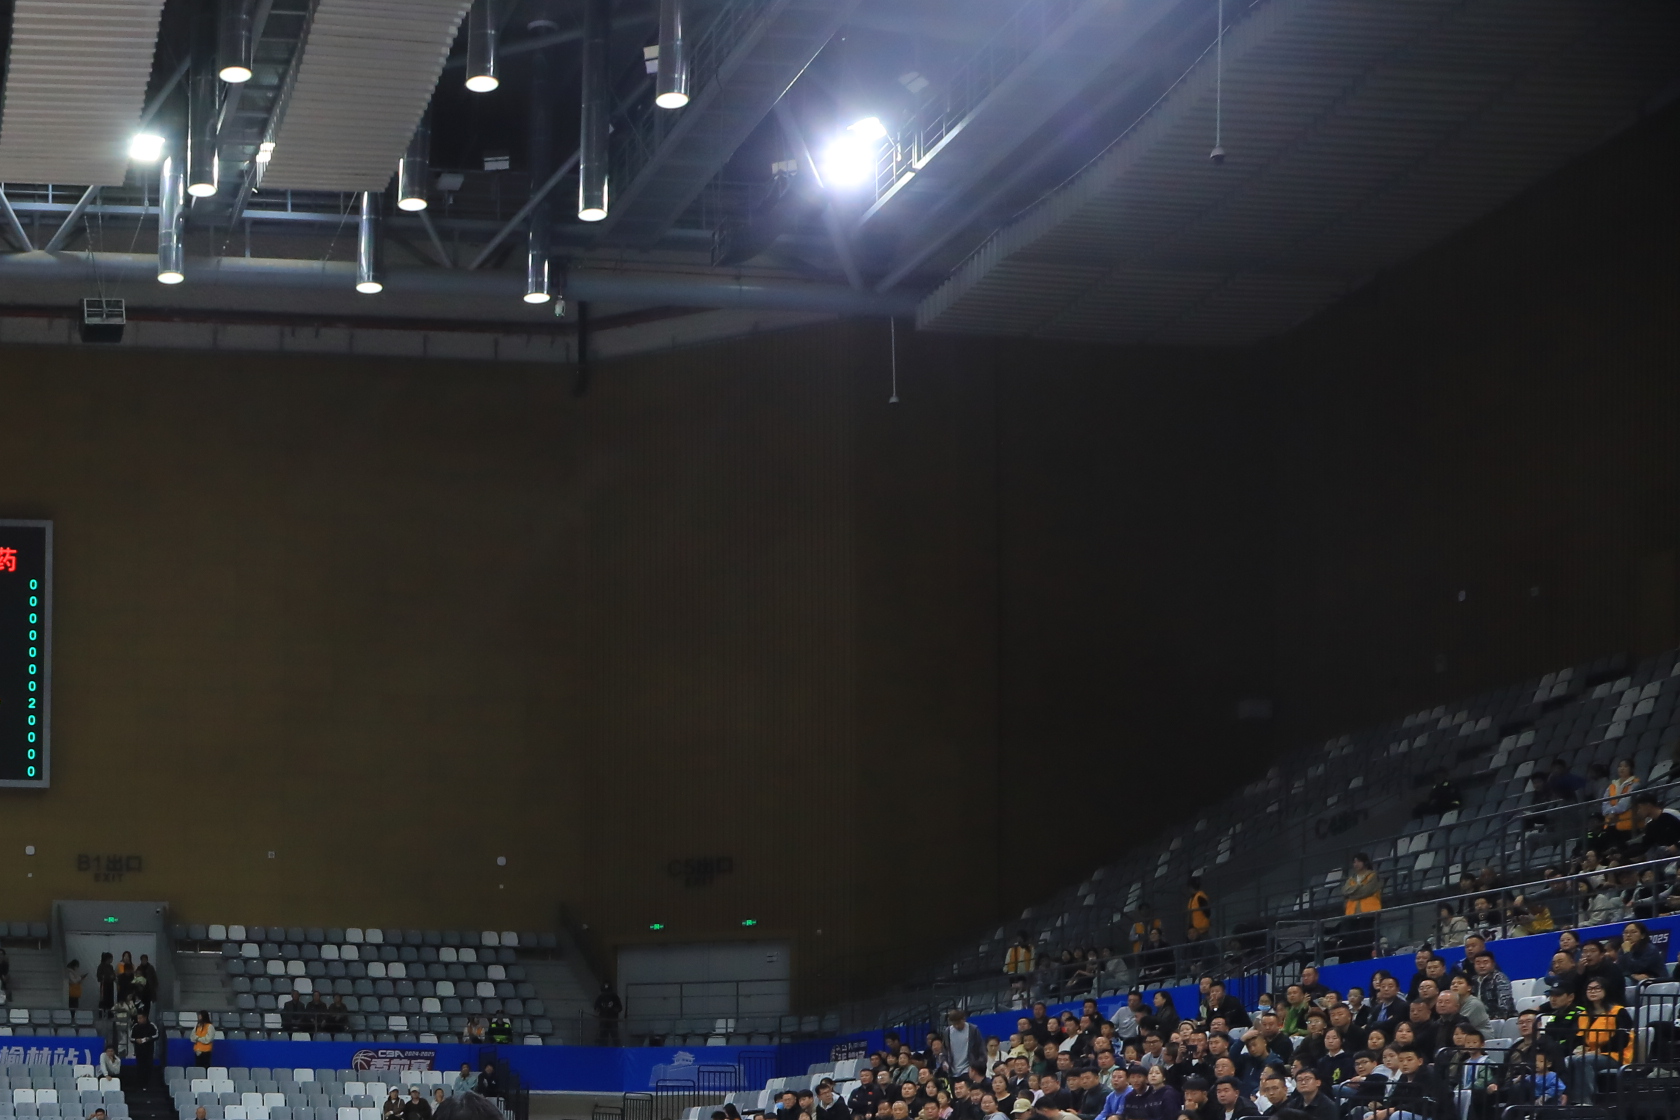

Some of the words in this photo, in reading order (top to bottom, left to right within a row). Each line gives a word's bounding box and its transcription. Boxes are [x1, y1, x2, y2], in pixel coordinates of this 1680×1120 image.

[30, 579, 37, 590] 0
[30, 596, 37, 606] 0
[29, 613, 37, 623] 0
[29, 630, 36, 640] 0
[29, 647, 36, 657] 0
[29, 664, 36, 674] 0
[28, 681, 36, 691] 0
[28, 698, 36, 708] 2
[28, 715, 35, 725] 0
[28, 732, 35, 742] 0
[28, 749, 35, 759] 0
[27, 766, 35, 776] 0
[77, 853, 142, 872] B1出口
